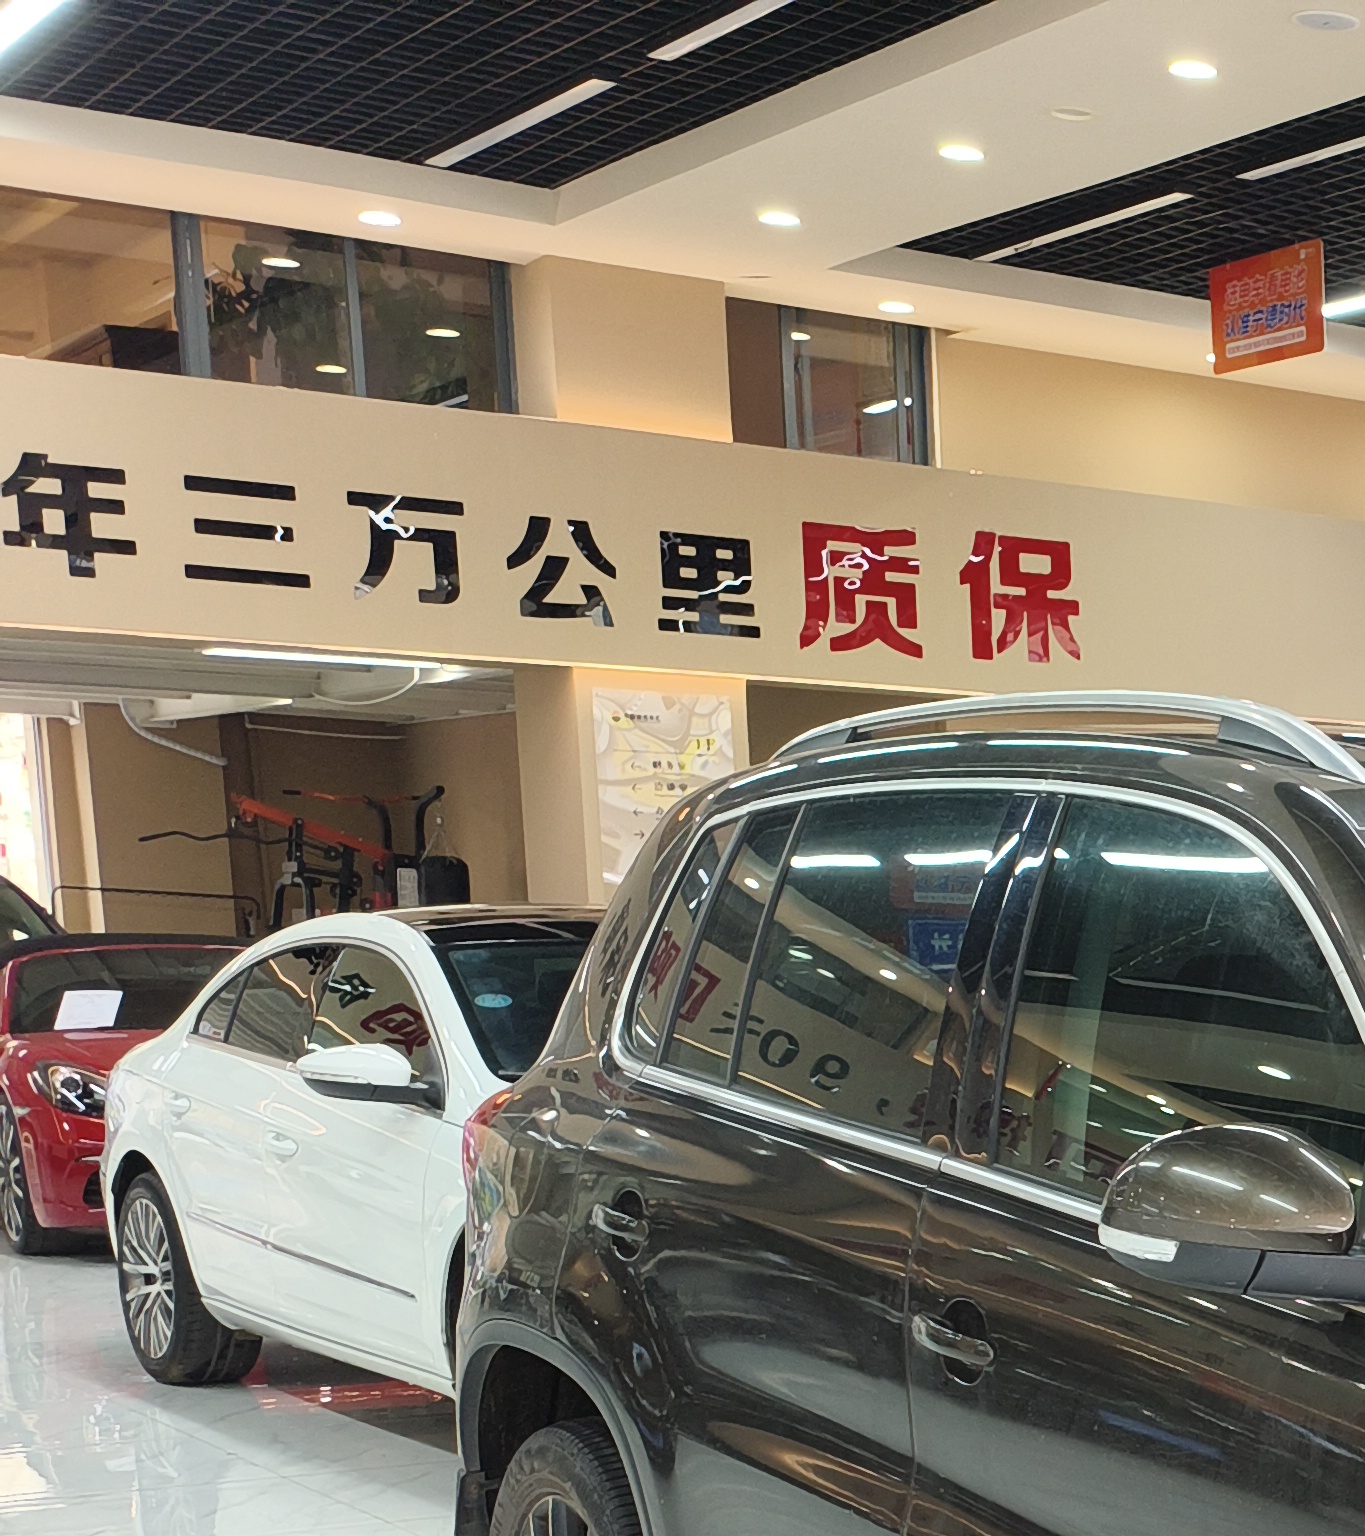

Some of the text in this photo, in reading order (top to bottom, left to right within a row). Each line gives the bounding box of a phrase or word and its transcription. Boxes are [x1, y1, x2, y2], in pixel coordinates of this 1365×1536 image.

[1224, 295, 1308, 340] 认准宁德时代
[1, 452, 1082, 664] 年三万公里质保
